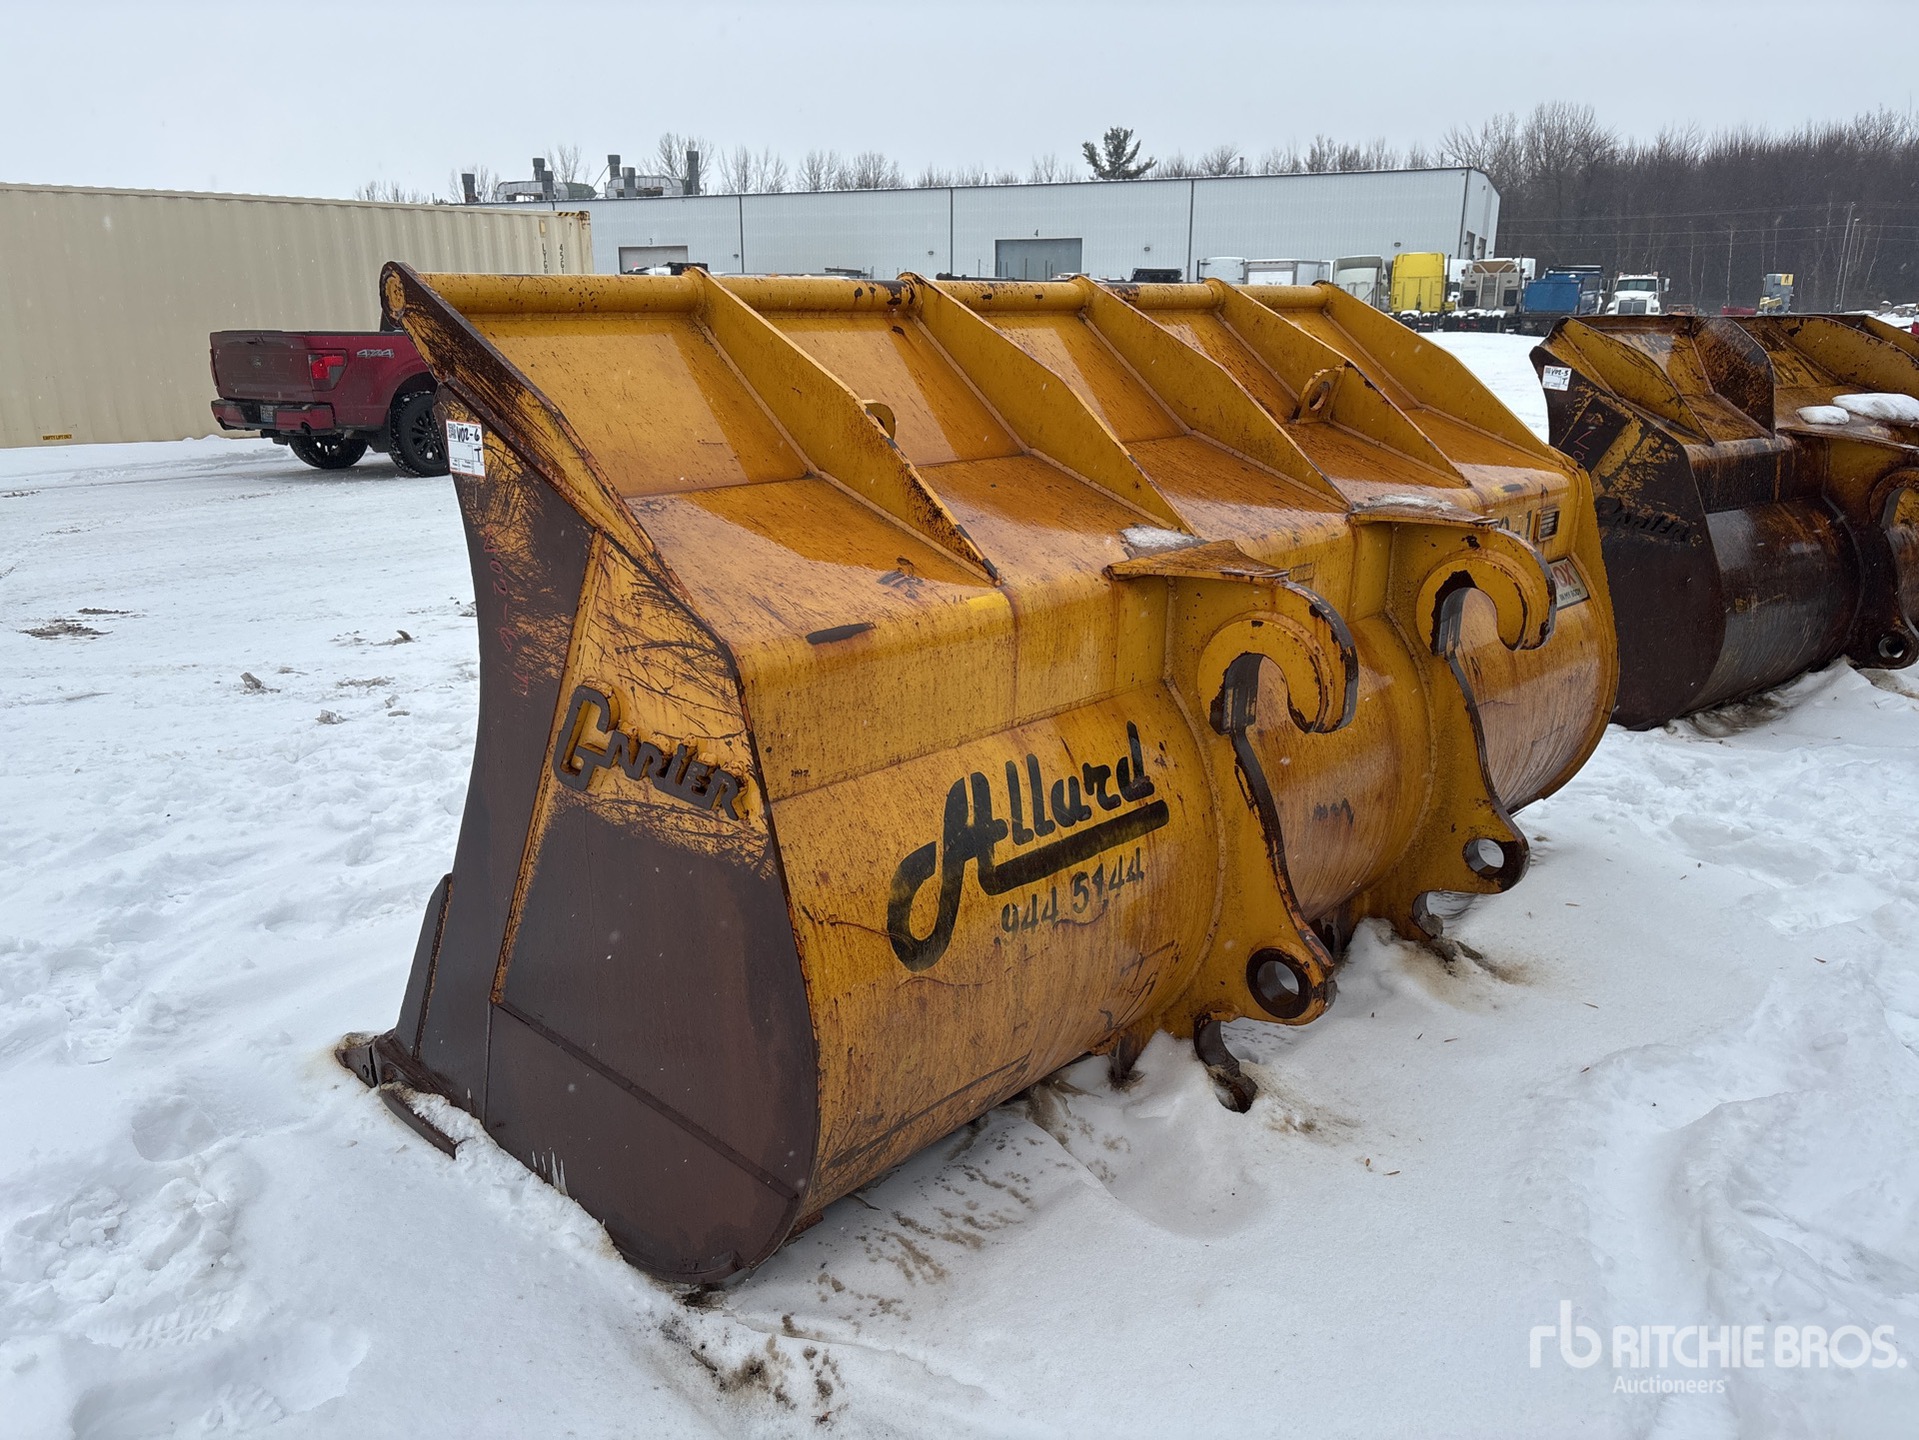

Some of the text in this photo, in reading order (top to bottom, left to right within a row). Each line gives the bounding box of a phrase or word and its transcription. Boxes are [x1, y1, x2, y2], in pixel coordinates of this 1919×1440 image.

[648, 237, 653, 245] 3
[1033, 229, 1039, 237] 4
[456, 426, 481, 442] V02-6
[473, 447, 482, 462] T
[1553, 563, 1576, 588] OX
[887, 721, 1168, 973] Allard
[1001, 846, 1145, 936] 944 5144
